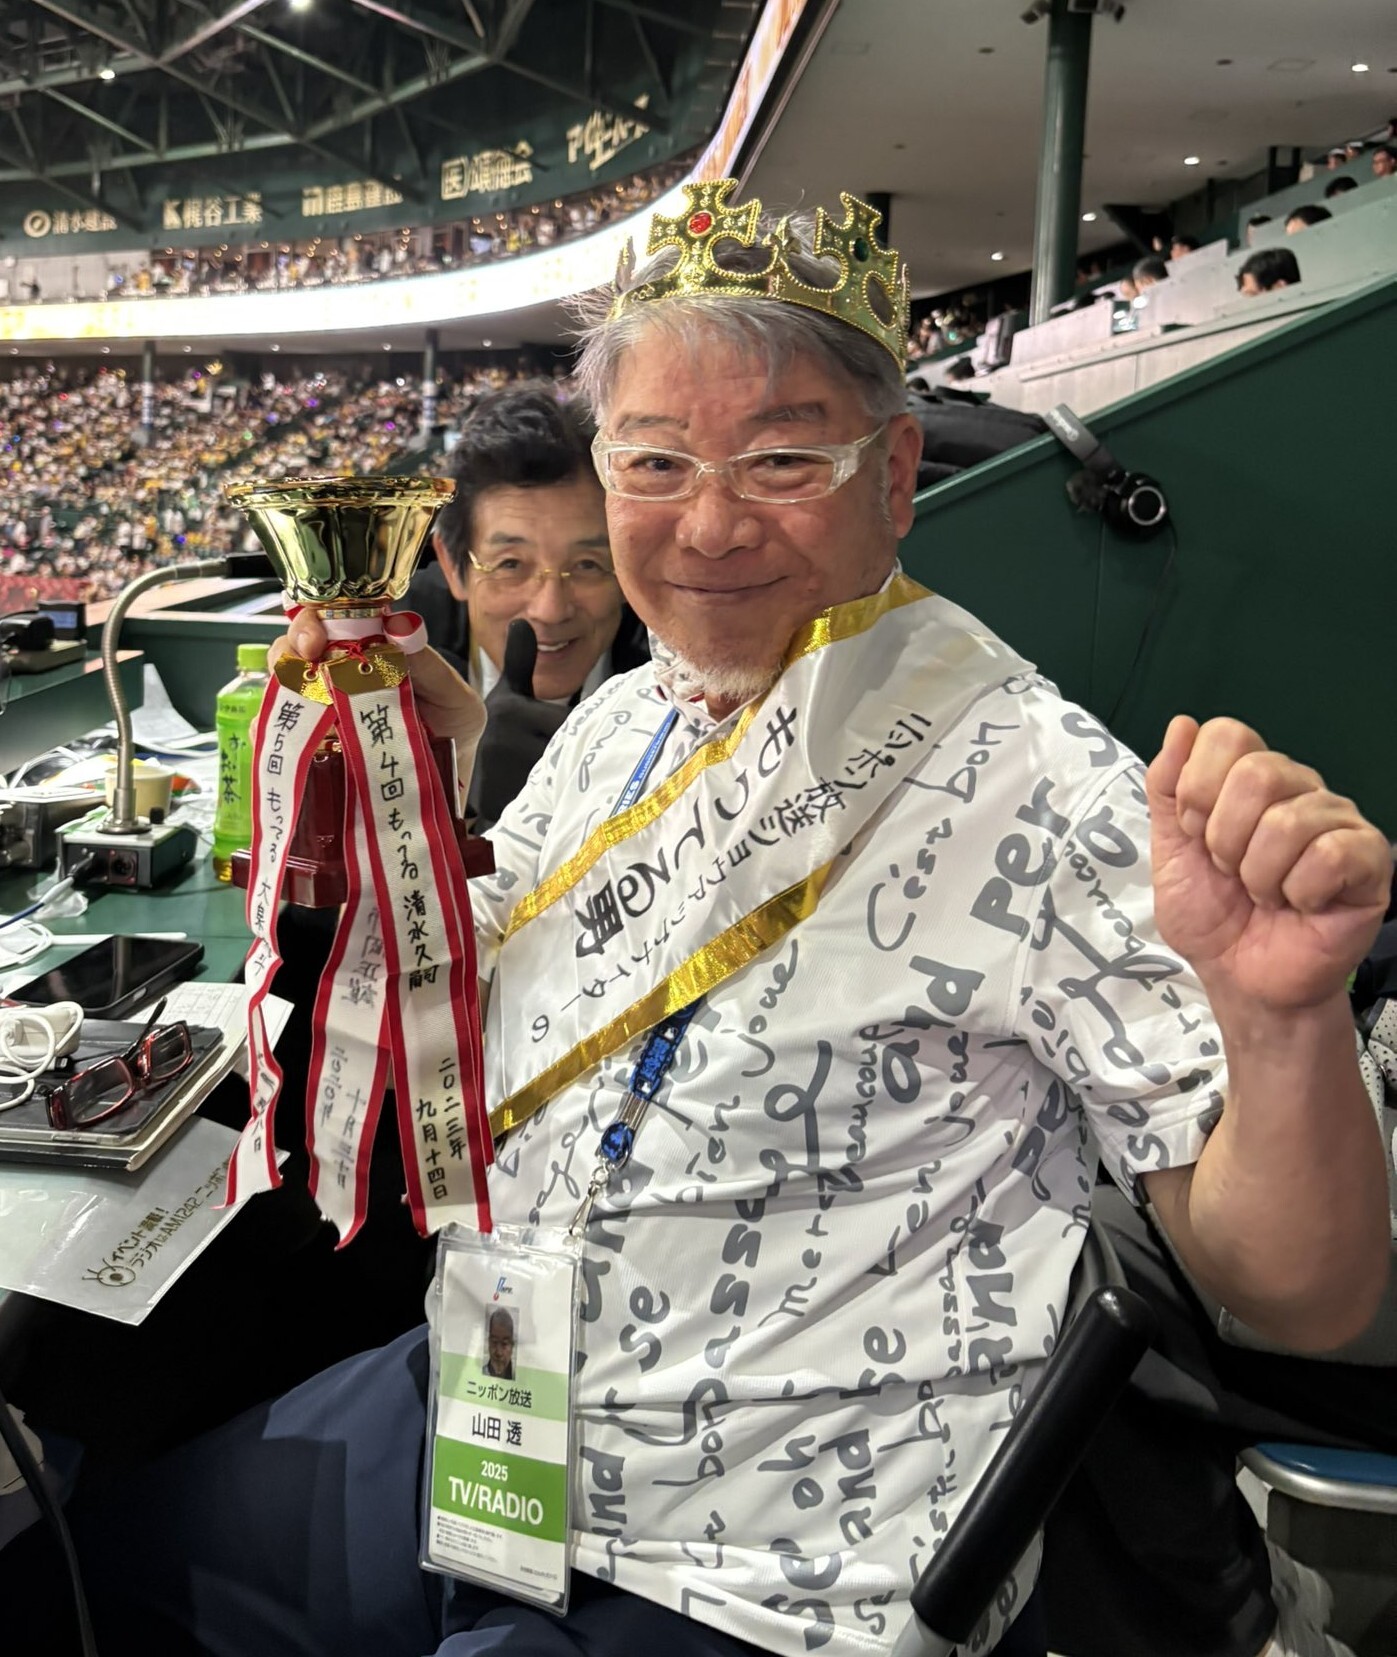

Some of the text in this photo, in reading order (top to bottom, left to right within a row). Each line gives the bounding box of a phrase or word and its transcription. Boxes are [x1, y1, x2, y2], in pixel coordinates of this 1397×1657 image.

[575, 706, 798, 958] もってる男
[416, 1099, 448, 1200] 九月十四日
[467, 1381, 532, 1408] ニッポン放送
[472, 1413, 522, 1446] 山田 透
[481, 1460, 508, 1482] 2025
[448, 1475, 544, 1525] TV/RADIO
